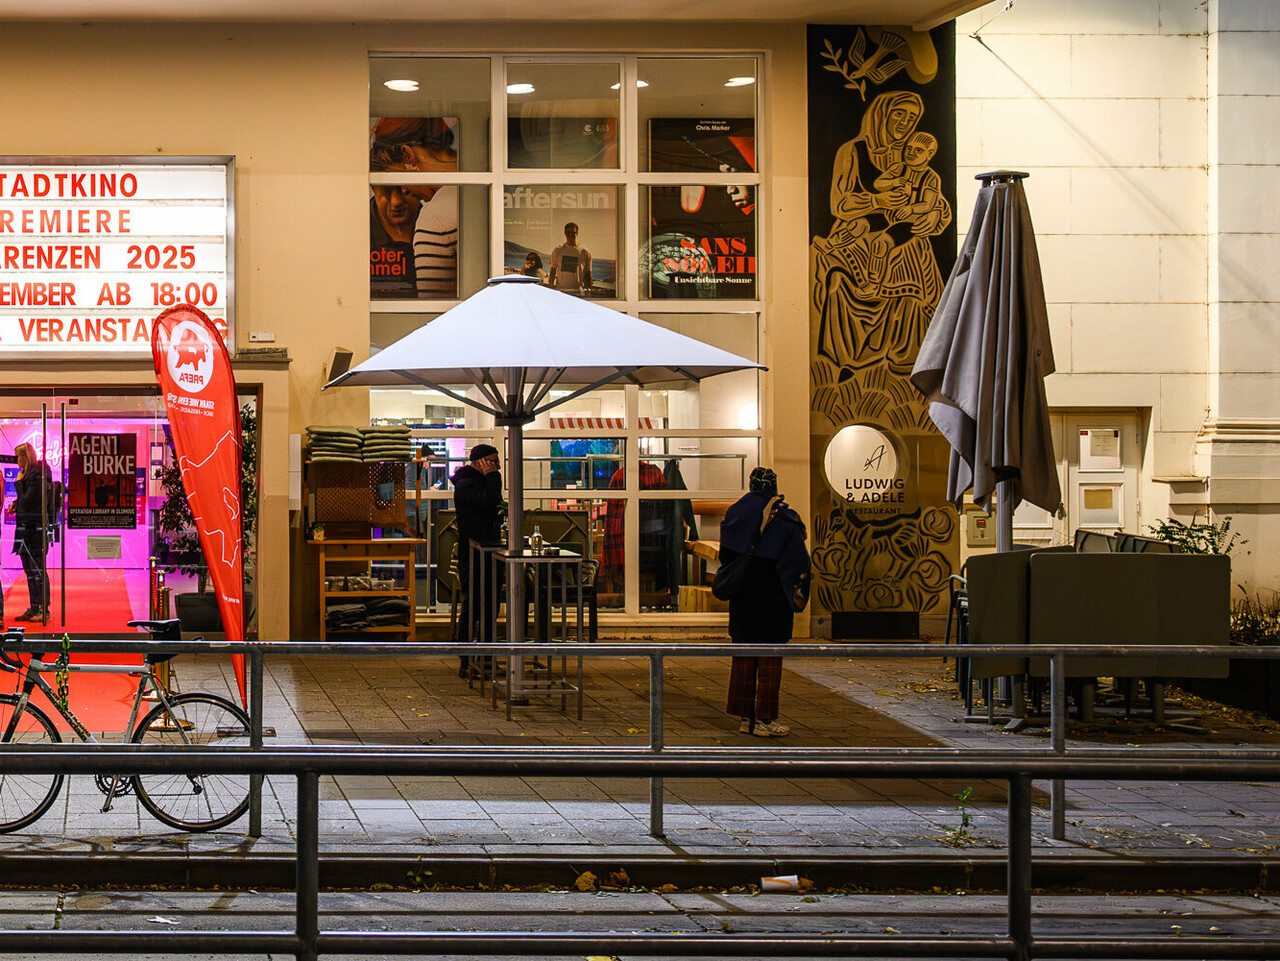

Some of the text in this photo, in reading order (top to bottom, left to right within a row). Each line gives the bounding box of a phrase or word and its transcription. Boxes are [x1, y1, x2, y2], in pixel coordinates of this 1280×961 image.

[503, 187, 609, 209] aftersun
[680, 237, 747, 255] SANS
[126, 244, 196, 270] 2025
[674, 276, 752, 285] Unsichtbare Sonne
[96, 282, 132, 306] AB
[150, 281, 218, 307] 18:00
[70, 435, 118, 455] AGENT
[83, 455, 135, 475] BURKE
[845, 478, 905, 490] LUDWIG
[846, 492, 905, 503] & ADELE
[848, 507, 902, 515] RESTAURANT
